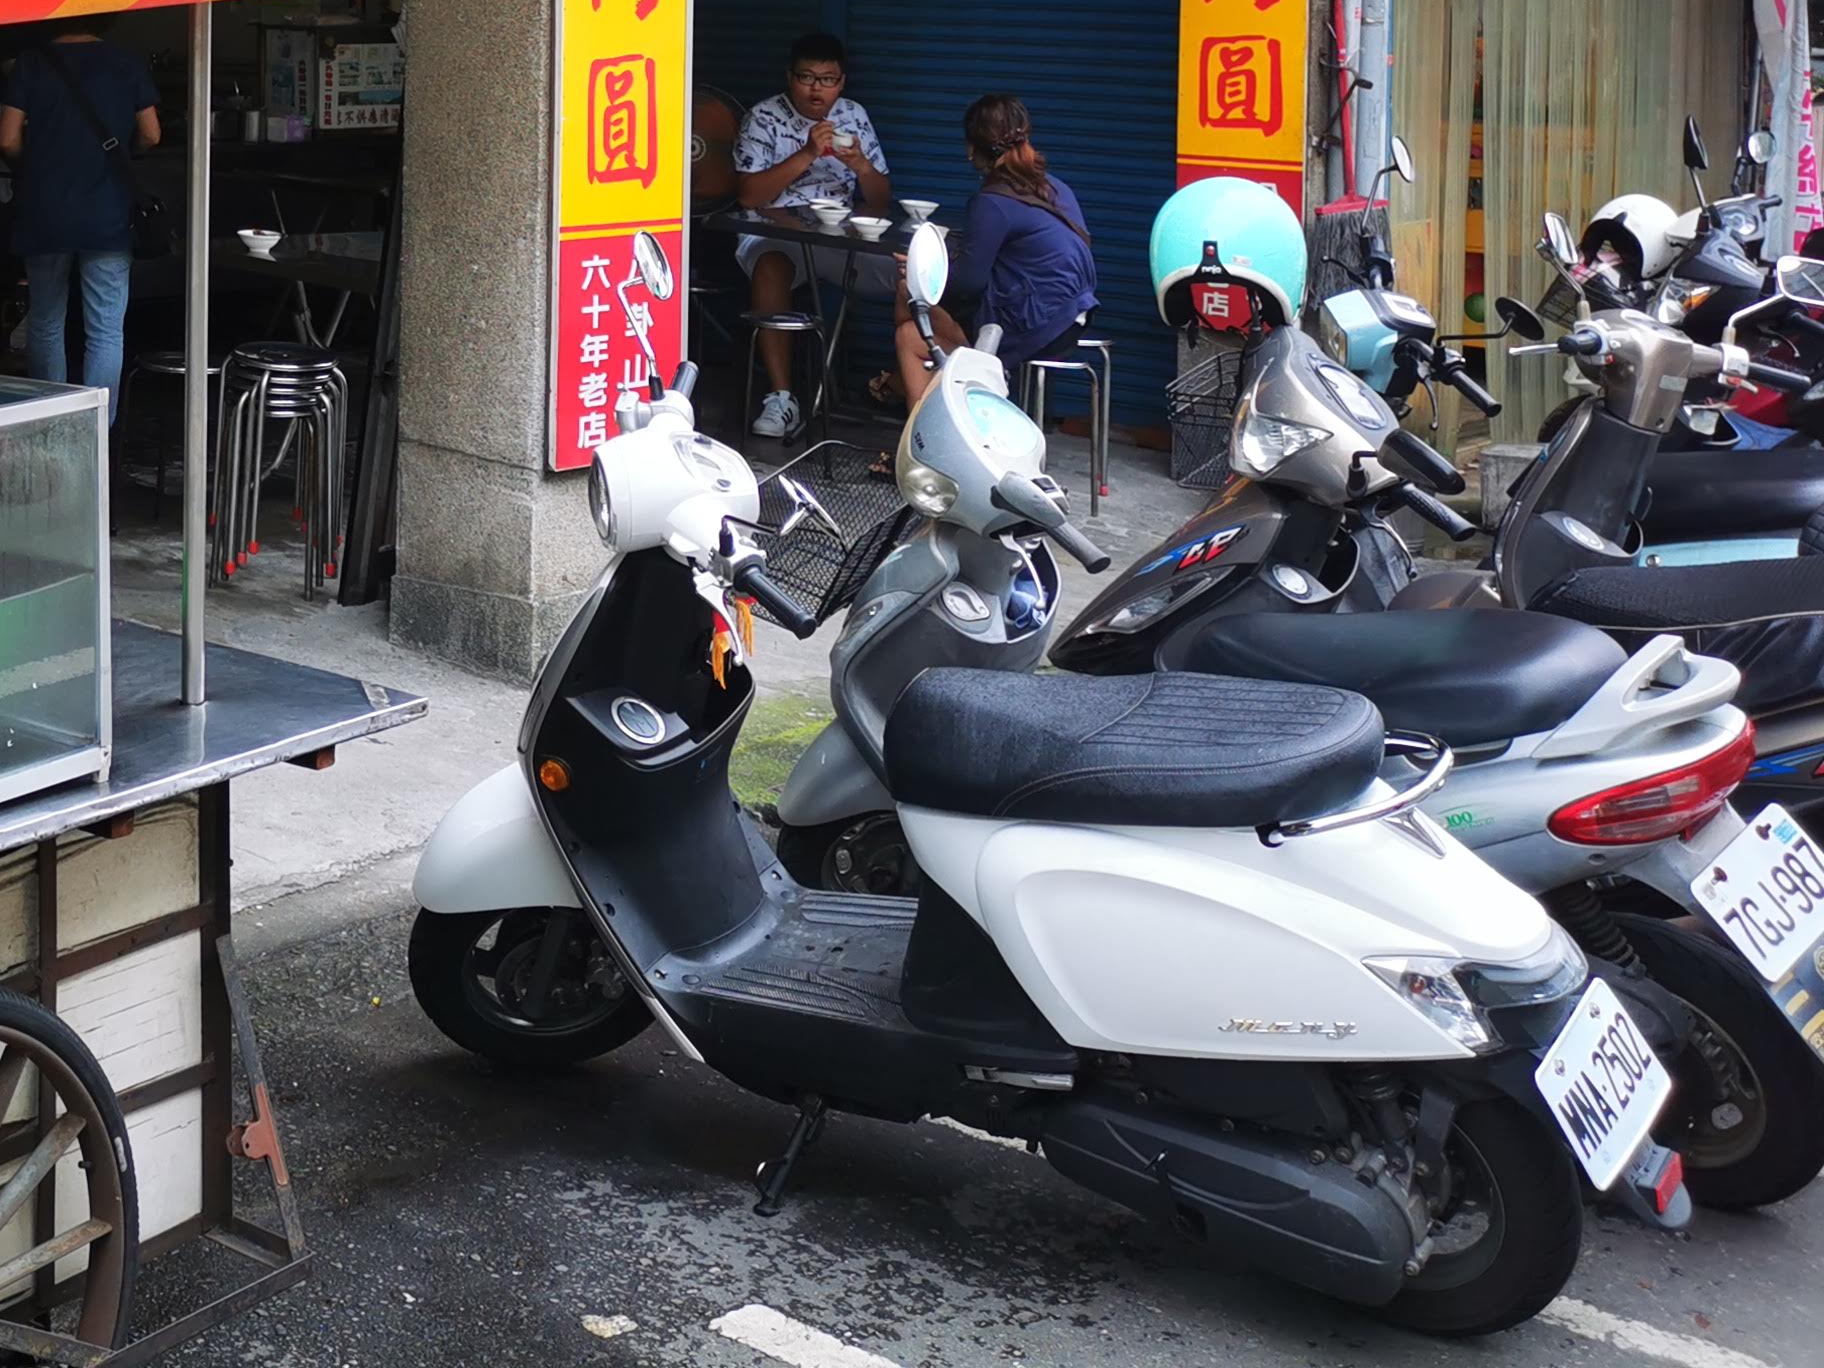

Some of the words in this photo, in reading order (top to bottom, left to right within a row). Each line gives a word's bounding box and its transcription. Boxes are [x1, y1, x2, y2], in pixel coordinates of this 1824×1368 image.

[577, 254, 611, 449] 六十年老店
